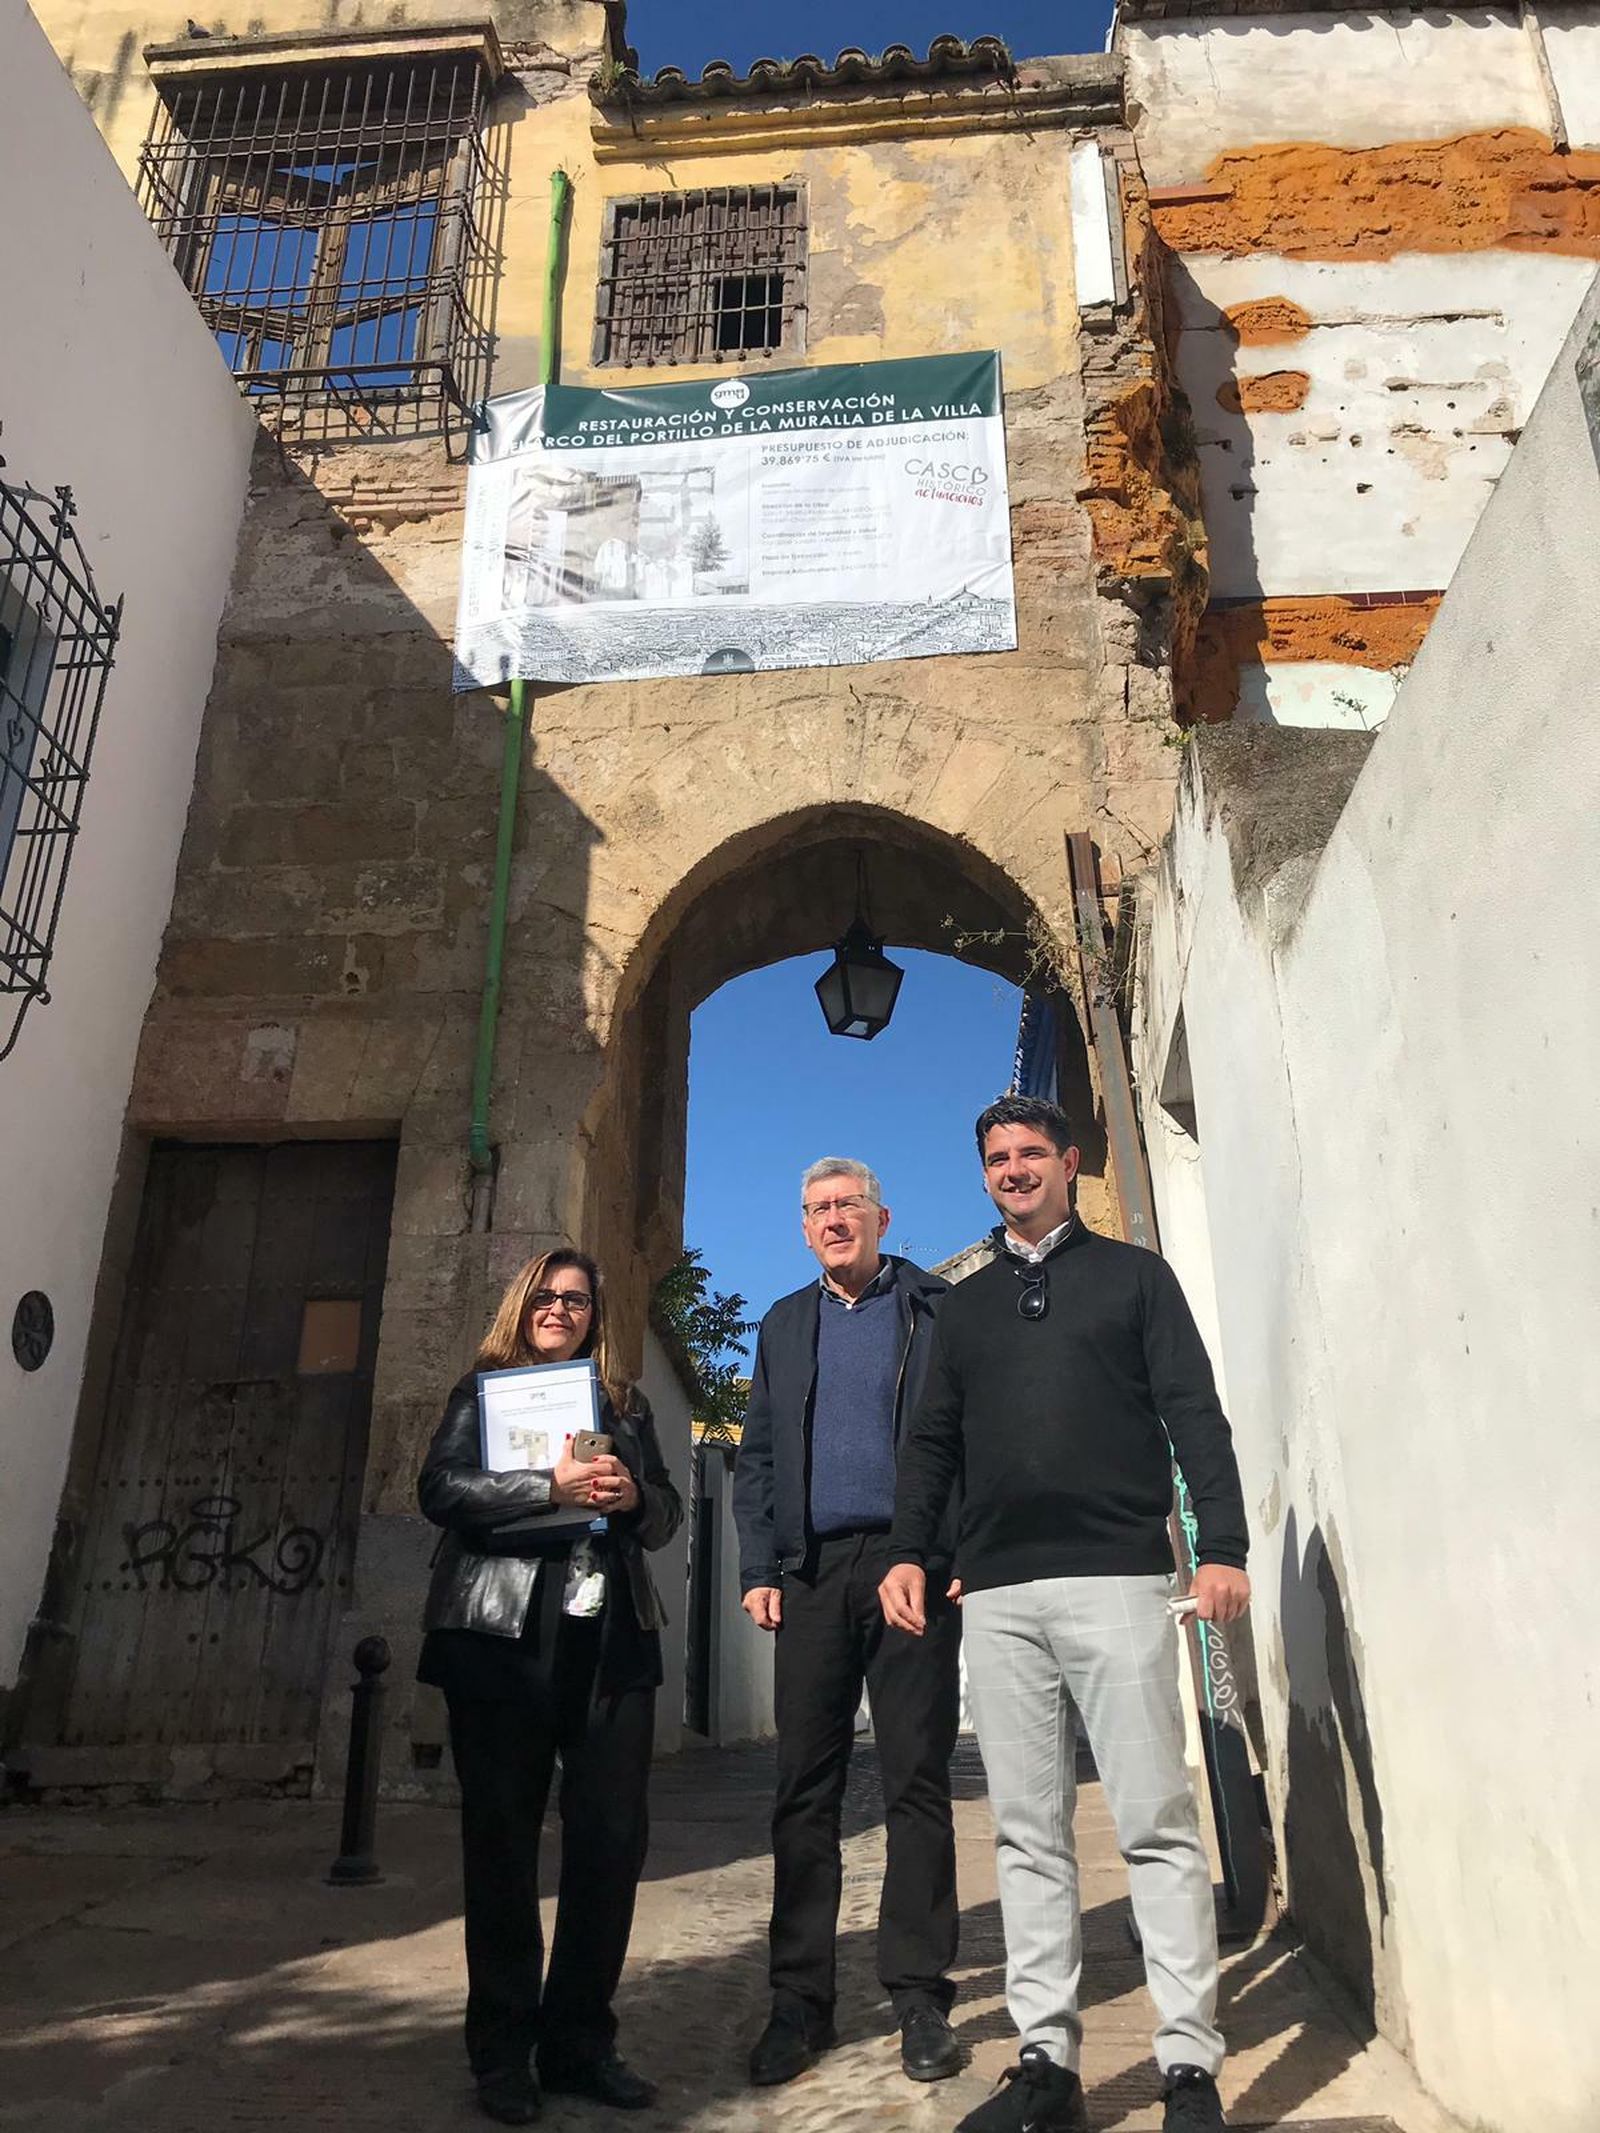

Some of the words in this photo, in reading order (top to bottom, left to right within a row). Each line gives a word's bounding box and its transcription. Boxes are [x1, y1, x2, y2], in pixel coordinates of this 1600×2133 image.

[578, 410, 717, 432] RESTAURACIÓN
[724, 409, 735, 420] Y
[741, 392, 895, 418] CONSERVACIÓN
[591, 434, 623, 447] DEL
[629, 425, 717, 443] PORTILLO
[720, 422, 744, 437] DE
[750, 418, 771, 432] LA
[778, 413, 864, 430] MURALLA
[872, 410, 895, 424] DE
[901, 408, 923, 420] LA
[930, 403, 983, 418] VILLA
[761, 440, 844, 453] PRESUPUESTO
[847, 439, 863, 450] DE
[866, 431, 970, 448] ADJUDICACIÓN:
